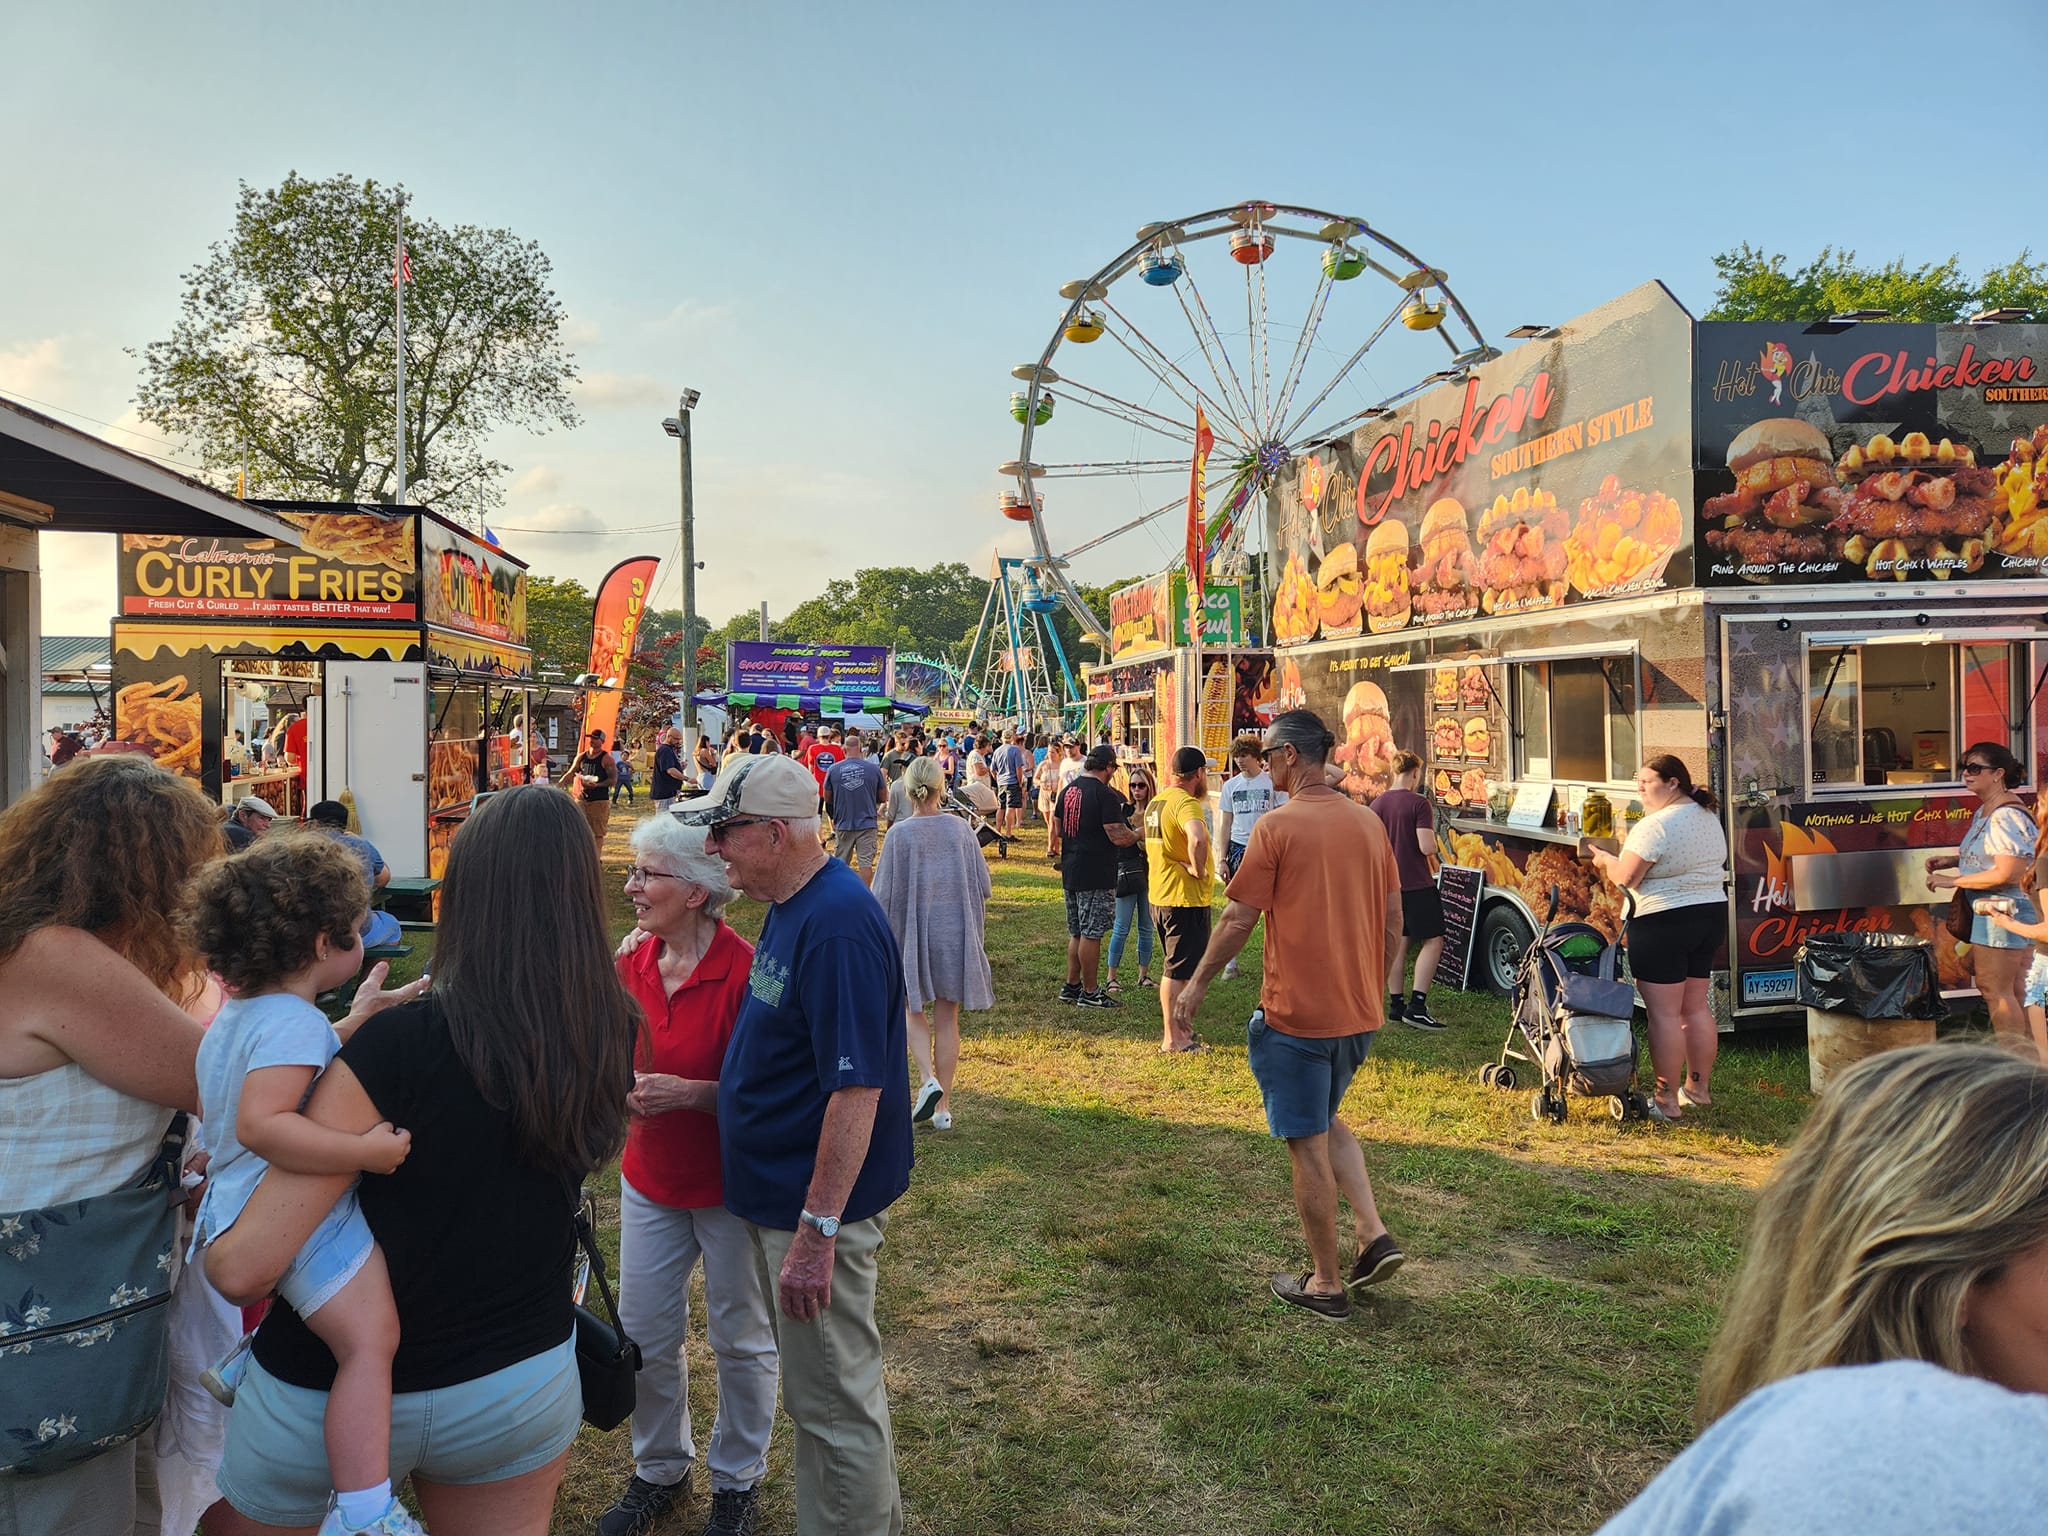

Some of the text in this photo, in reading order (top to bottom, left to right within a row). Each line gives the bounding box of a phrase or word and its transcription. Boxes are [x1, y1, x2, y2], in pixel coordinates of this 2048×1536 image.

[1713, 343, 2036, 406] Hot Chix Chicken
[1491, 396, 1654, 480] SOUTHERN STYLE
[1357, 372, 1556, 525] Chicken
[1711, 562, 1839, 577] RING AROUND THE CHICKEN
[1875, 559, 1894, 570] HOT
[1895, 559, 1919, 570] CHIX
[1927, 558, 1968, 570] WAFFLES
[136, 551, 404, 602] CURLY FRIES
[148, 599, 175, 609] FRESH
[176, 600, 194, 610] CUT
[196, 600, 205, 609] &
[206, 600, 239, 611] CURLED
[262, 603, 282, 611] JUST
[283, 604, 310, 612] TASTES
[311, 602, 351, 613] BETTER
[372, 605, 391, 614] WAY!
[1182, 618, 1233, 634] BWL
[738, 660, 810, 672] SMOOTHIES
[832, 666, 878, 674] BANANAS
[935, 710, 972, 718] TICKETS
[1804, 807, 1973, 827] NOTHING LIKE HOT CHIX WITH
